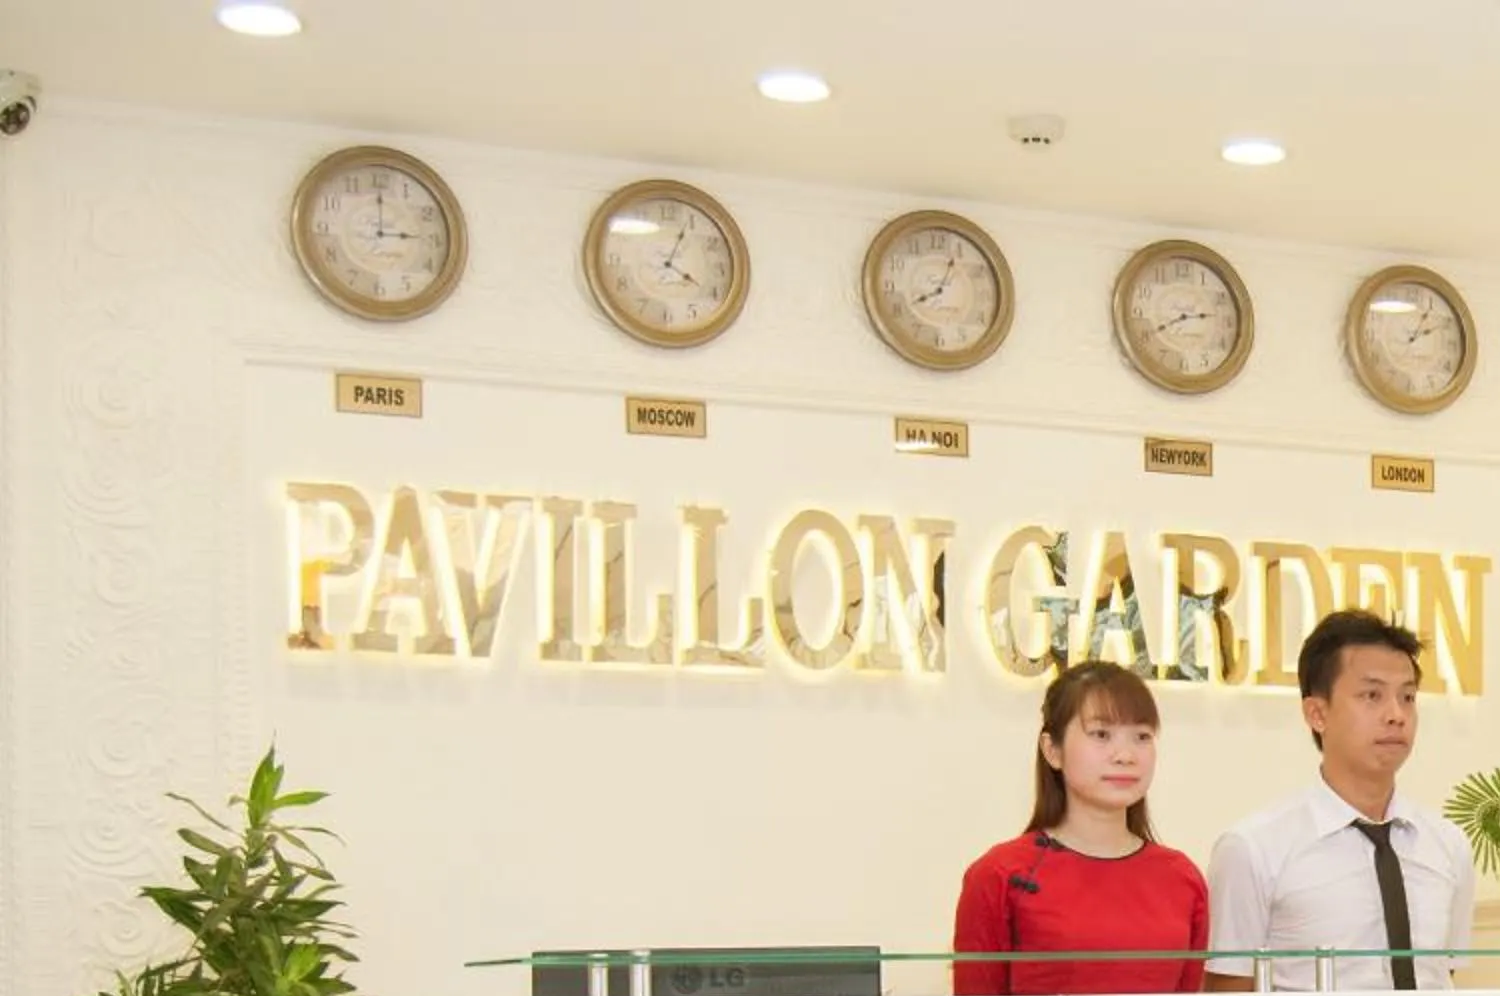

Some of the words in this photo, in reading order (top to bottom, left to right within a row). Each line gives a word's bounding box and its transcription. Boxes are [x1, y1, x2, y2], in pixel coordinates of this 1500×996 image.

[353, 385, 405, 407] PARIS
[637, 407, 697, 428] MOSCOW
[1151, 447, 1208, 467] NEWYORK
[1381, 464, 1425, 484] LONDON
[285, 481, 956, 674] PAVILLON
[709, 966, 745, 989] LG
